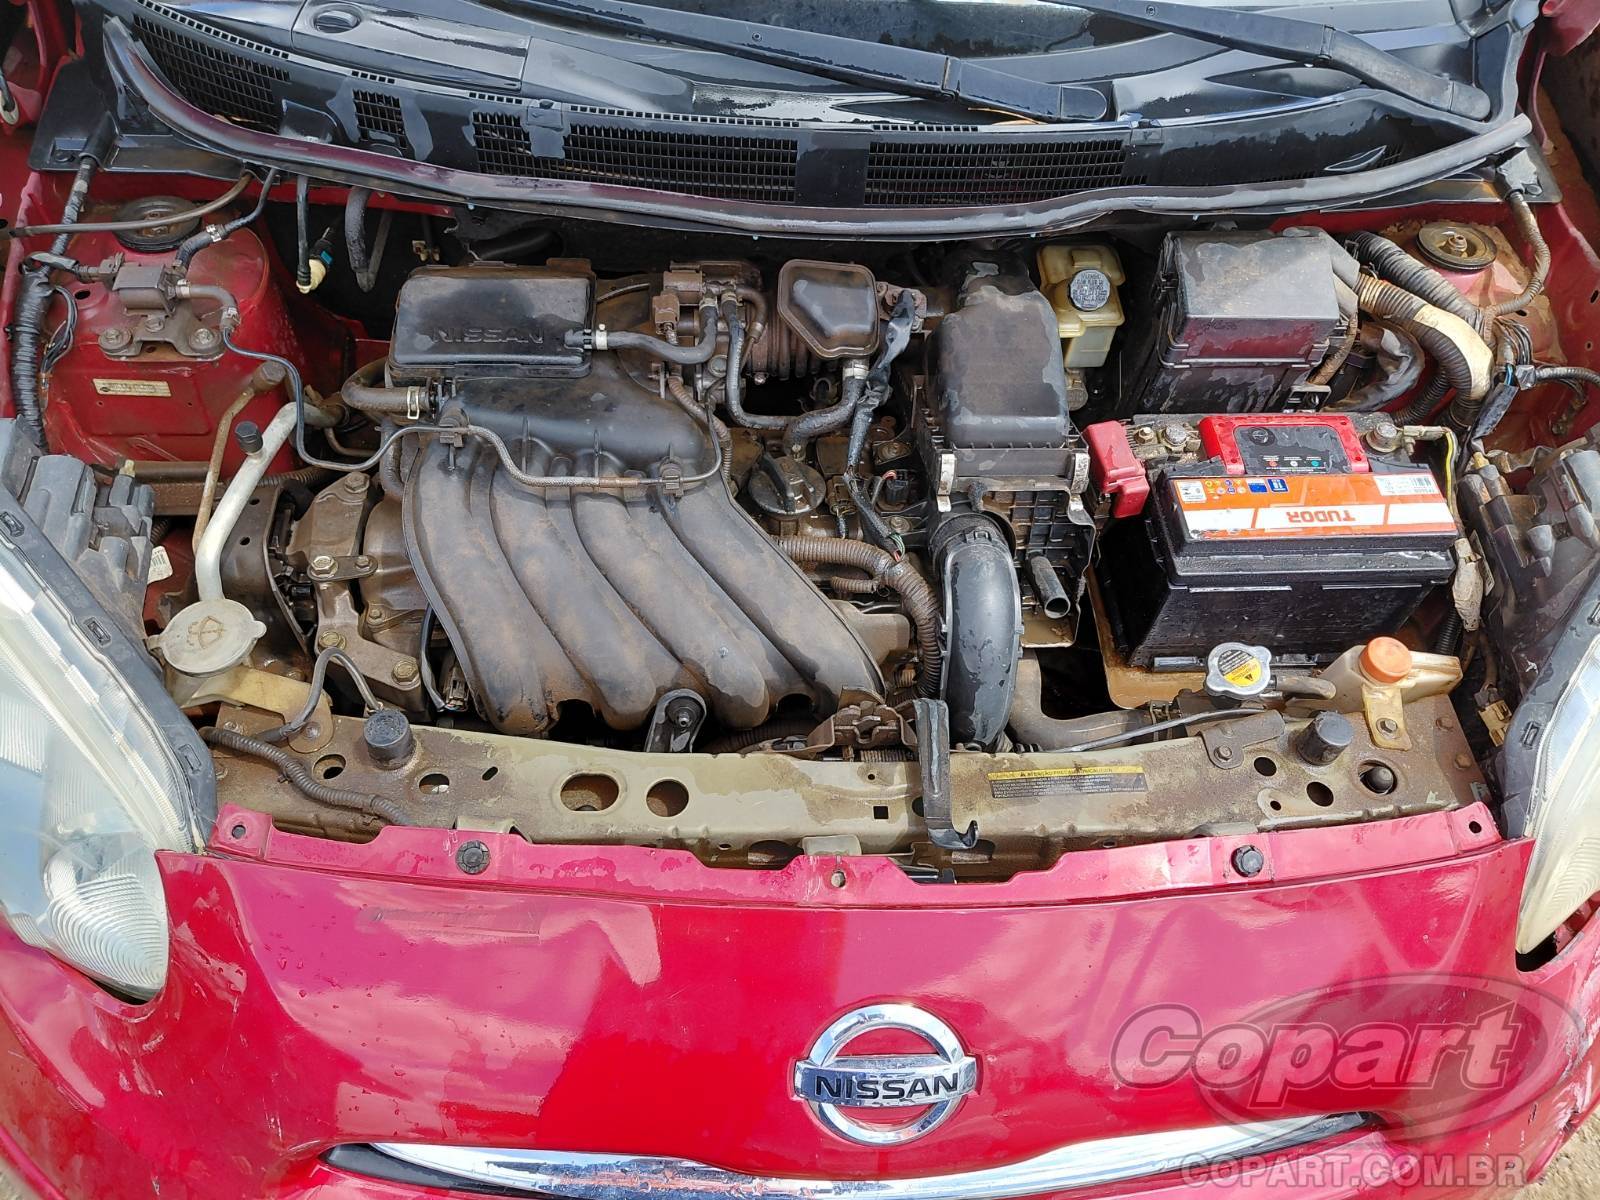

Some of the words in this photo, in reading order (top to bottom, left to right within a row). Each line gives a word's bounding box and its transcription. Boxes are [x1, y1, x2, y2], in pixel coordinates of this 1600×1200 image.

[431, 326, 544, 343] NISSAN
[1285, 509, 1356, 524] TUDOR
[815, 1073, 959, 1100] NISSAN
